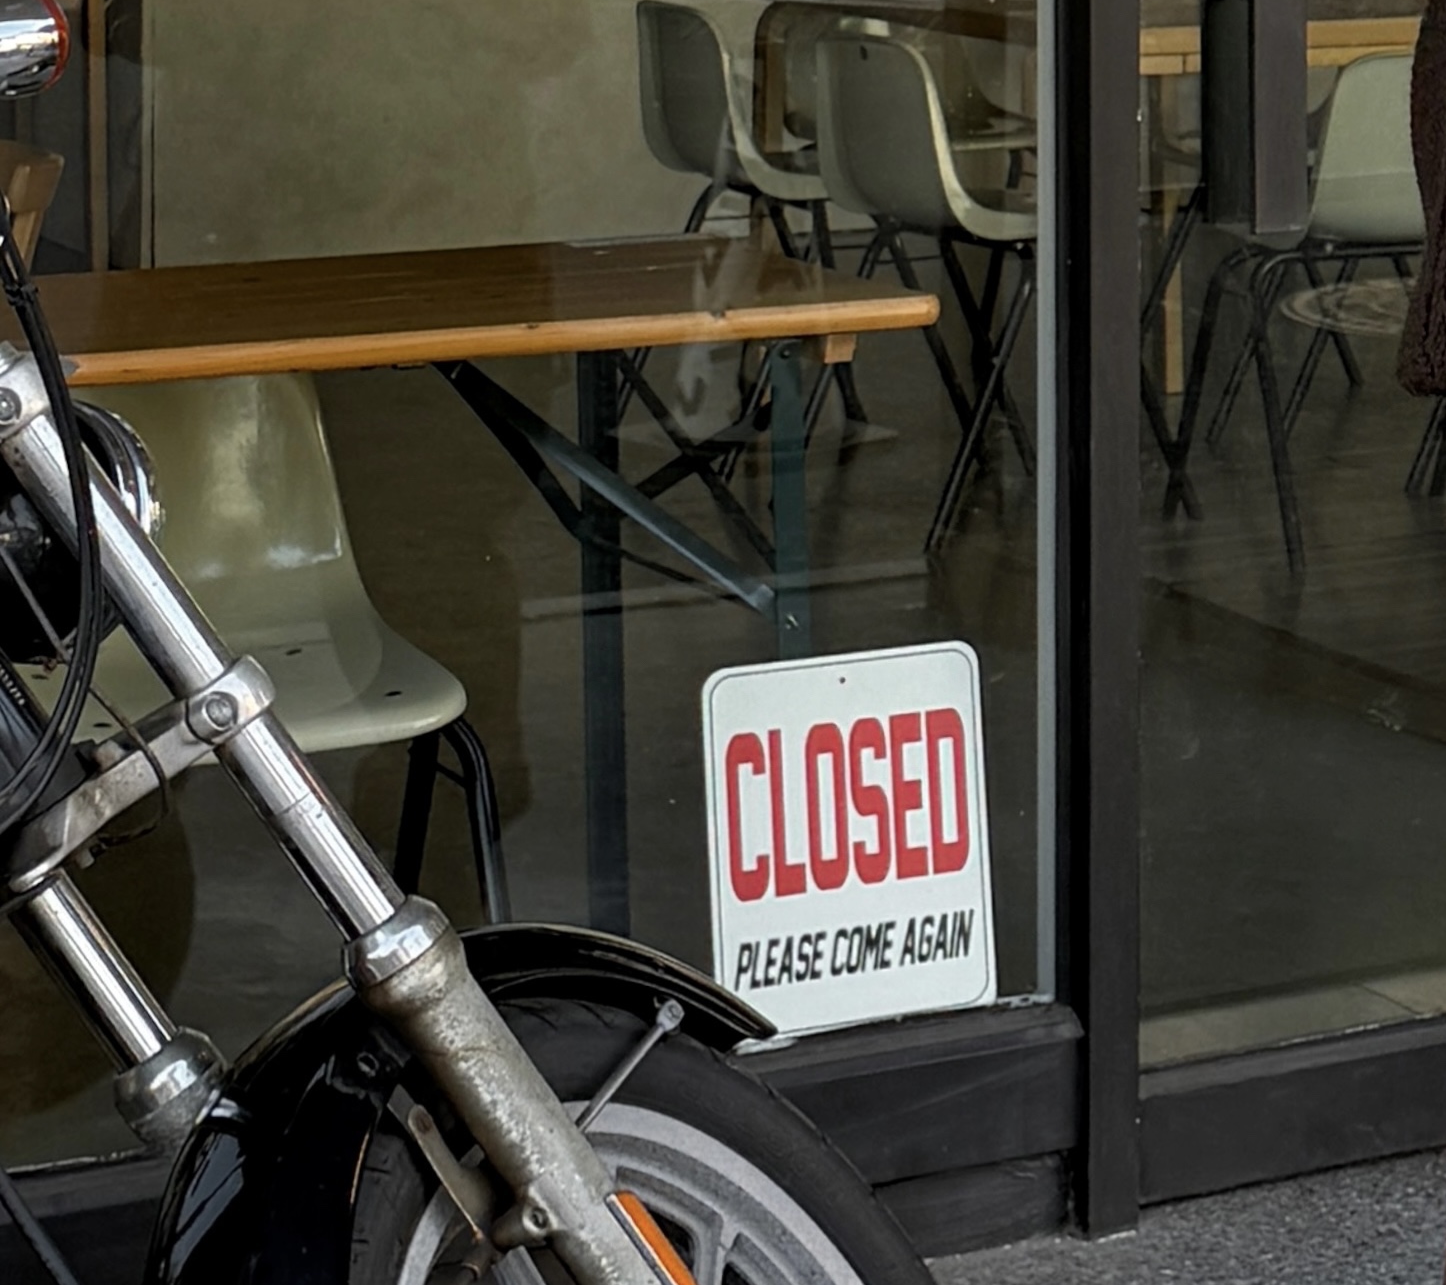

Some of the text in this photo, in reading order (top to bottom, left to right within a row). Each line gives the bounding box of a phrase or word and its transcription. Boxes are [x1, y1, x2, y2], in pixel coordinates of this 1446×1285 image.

[724, 707, 969, 902] CLOSED
[734, 908, 974, 991] PLEASE COME AGAIN
